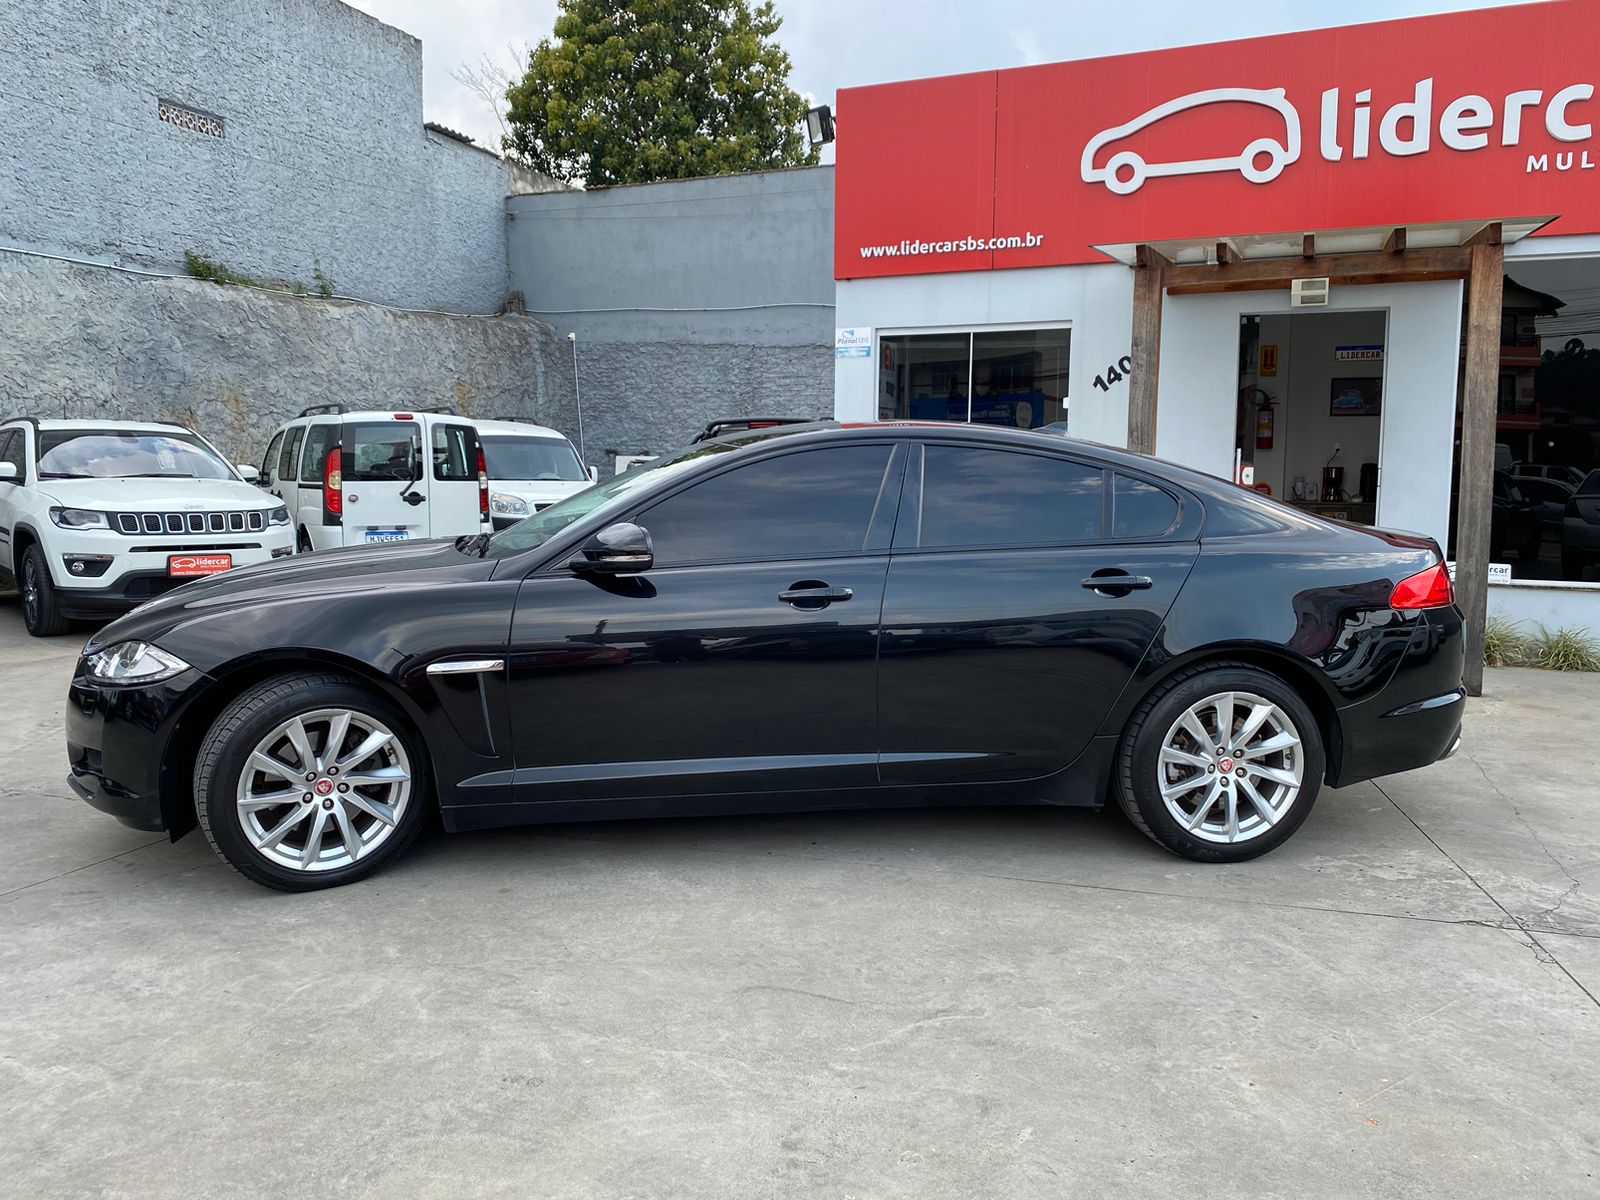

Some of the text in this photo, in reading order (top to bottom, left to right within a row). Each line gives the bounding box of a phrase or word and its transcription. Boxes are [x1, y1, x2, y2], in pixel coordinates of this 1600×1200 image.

[860, 232, 1044, 258] www.lidercarsbs.com.br
[1340, 351, 1381, 360] LIDERCAR
[1093, 355, 1131, 392] 140
[196, 557, 229, 565] lidercar
